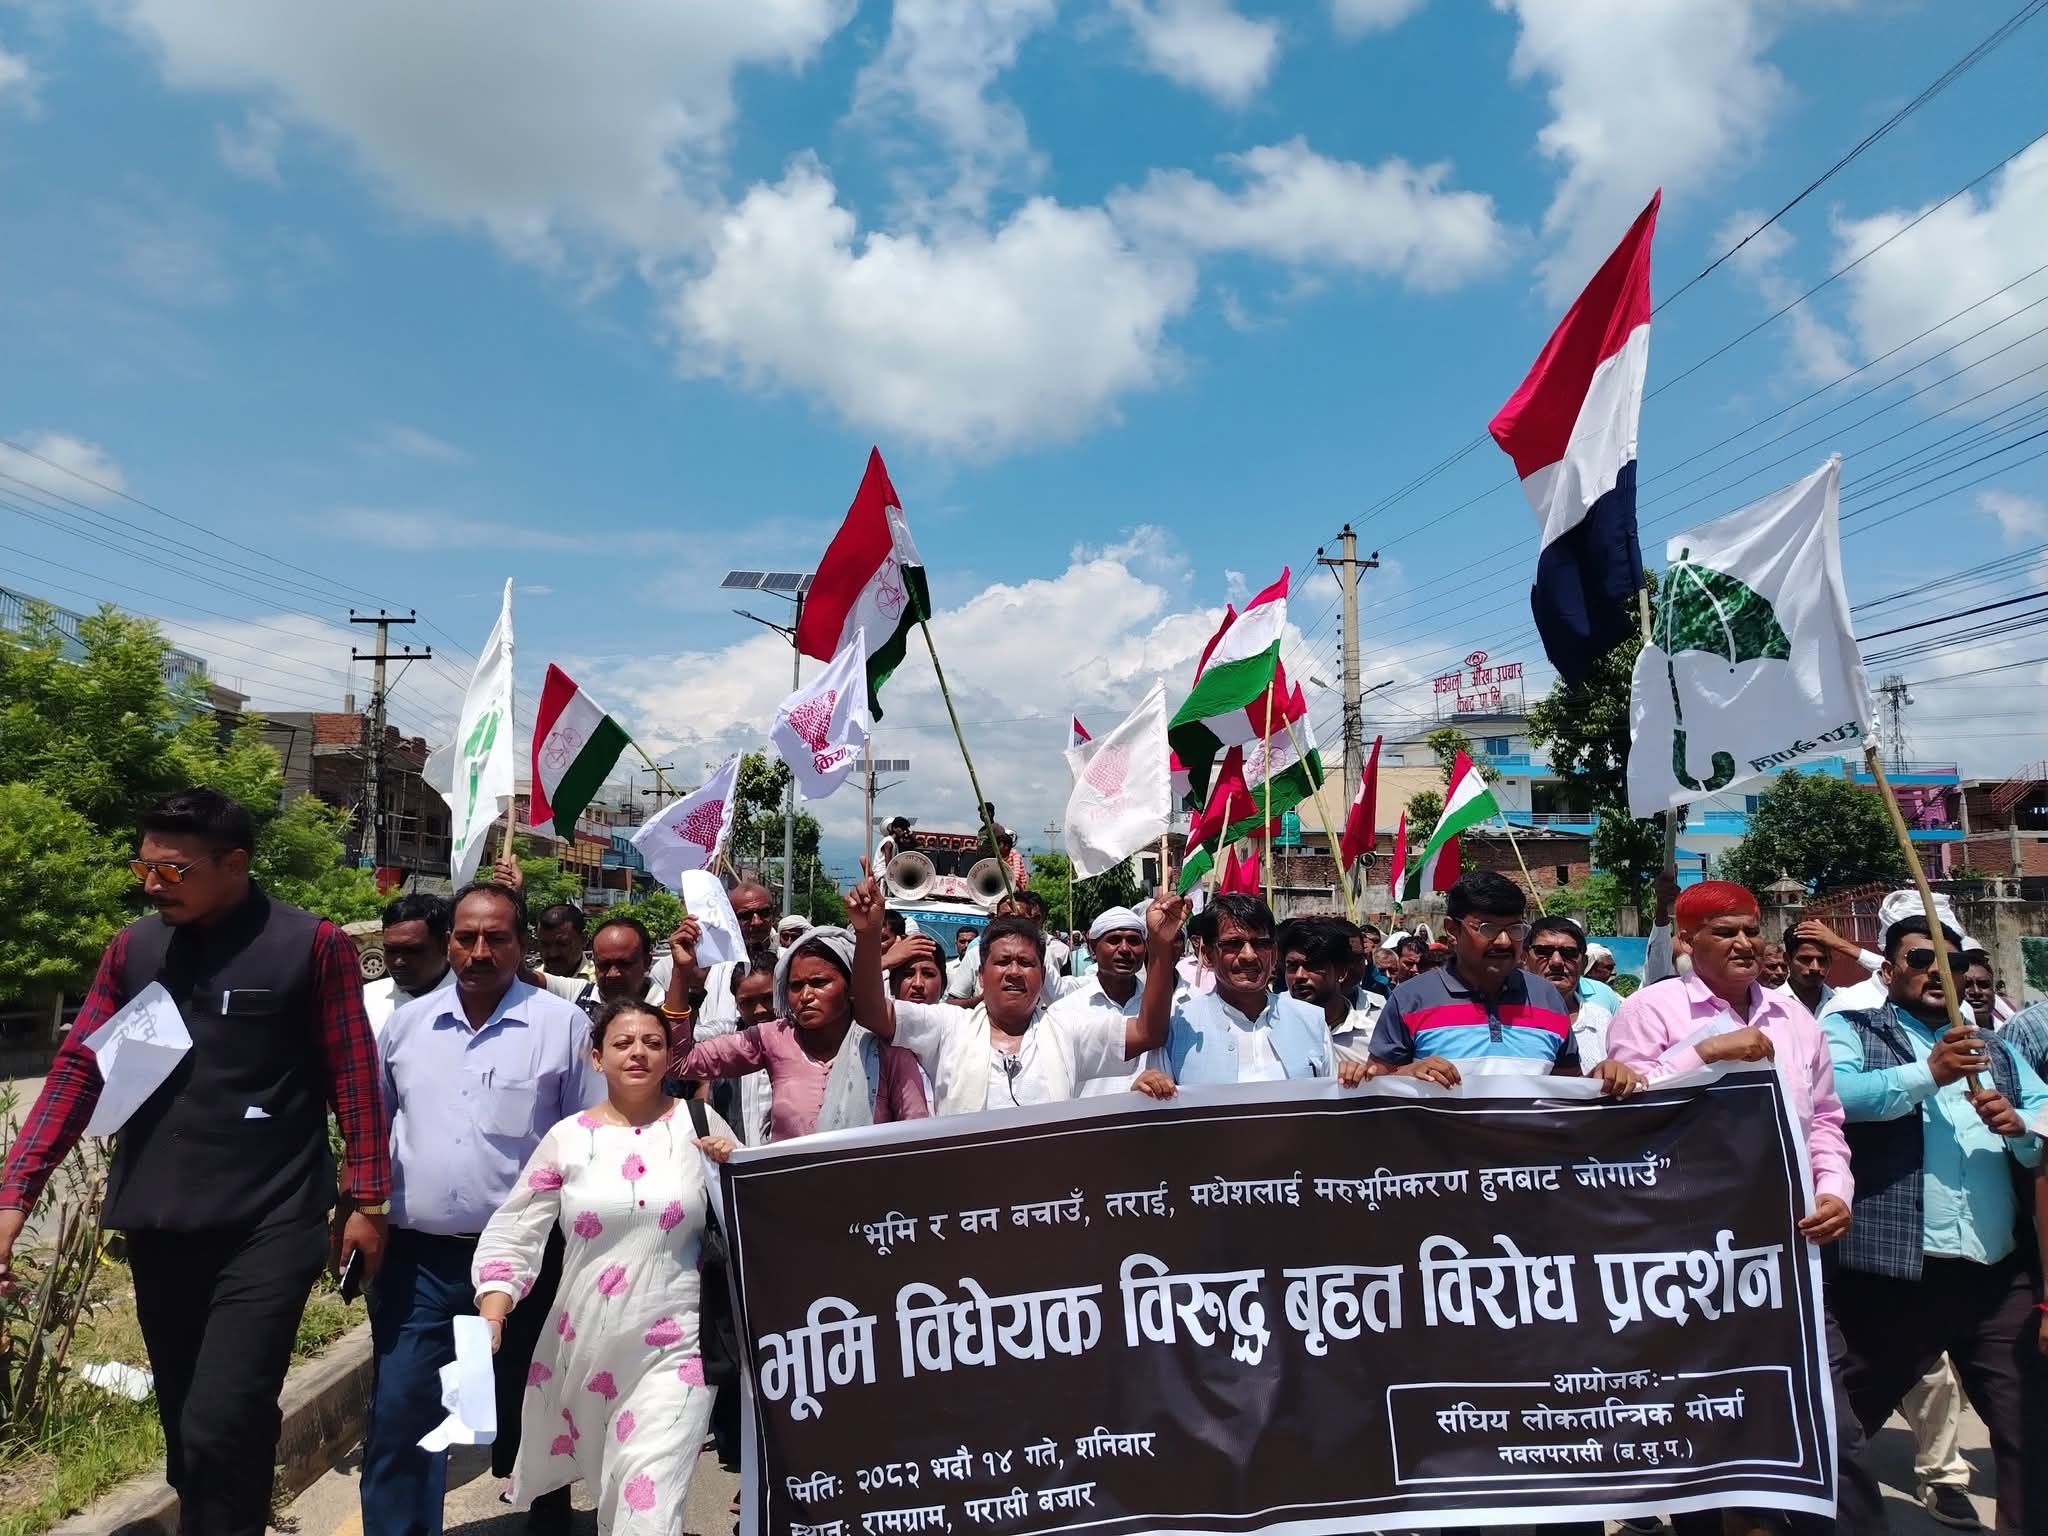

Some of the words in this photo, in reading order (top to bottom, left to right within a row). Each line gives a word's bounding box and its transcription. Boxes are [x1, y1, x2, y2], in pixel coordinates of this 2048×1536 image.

[929, 1215, 948, 1240] र
[960, 1208, 1000, 1233] वन
[1011, 1188, 1089, 1227] बचाउँ,
[1105, 1181, 1174, 1218] तराई,
[1190, 1171, 1303, 1206] मधेशलाई
[1314, 1168, 1469, 1210] मरुभूमिकरण
[1479, 1166, 1561, 1201] हुनबाट
[758, 1297, 876, 1420] भूमि
[896, 1278, 1102, 1377] विधेयक
[1283, 1265, 1403, 1356] बृहत
[1419, 1234, 1577, 1329] विरोध
[1594, 1230, 1783, 1333] प्रदर्शन
[1436, 1402, 1510, 1433] संघिय
[1521, 1397, 1674, 1430] लोकतान्त्रिक
[1685, 1388, 1744, 1421] मोर्चा
[857, 1462, 919, 1493] २०८२
[931, 1445, 973, 1480] भदौ
[983, 1450, 1012, 1476] १४
[1024, 1438, 1063, 1470] गते,
[1075, 1426, 1156, 1459] शनिवार
[1498, 1438, 1603, 1464] नवलपरासी
[861, 1505, 952, 1536] रामग्राम,
[964, 1487, 1028, 1523] परासी
[1037, 1482, 1096, 1511] बजार
